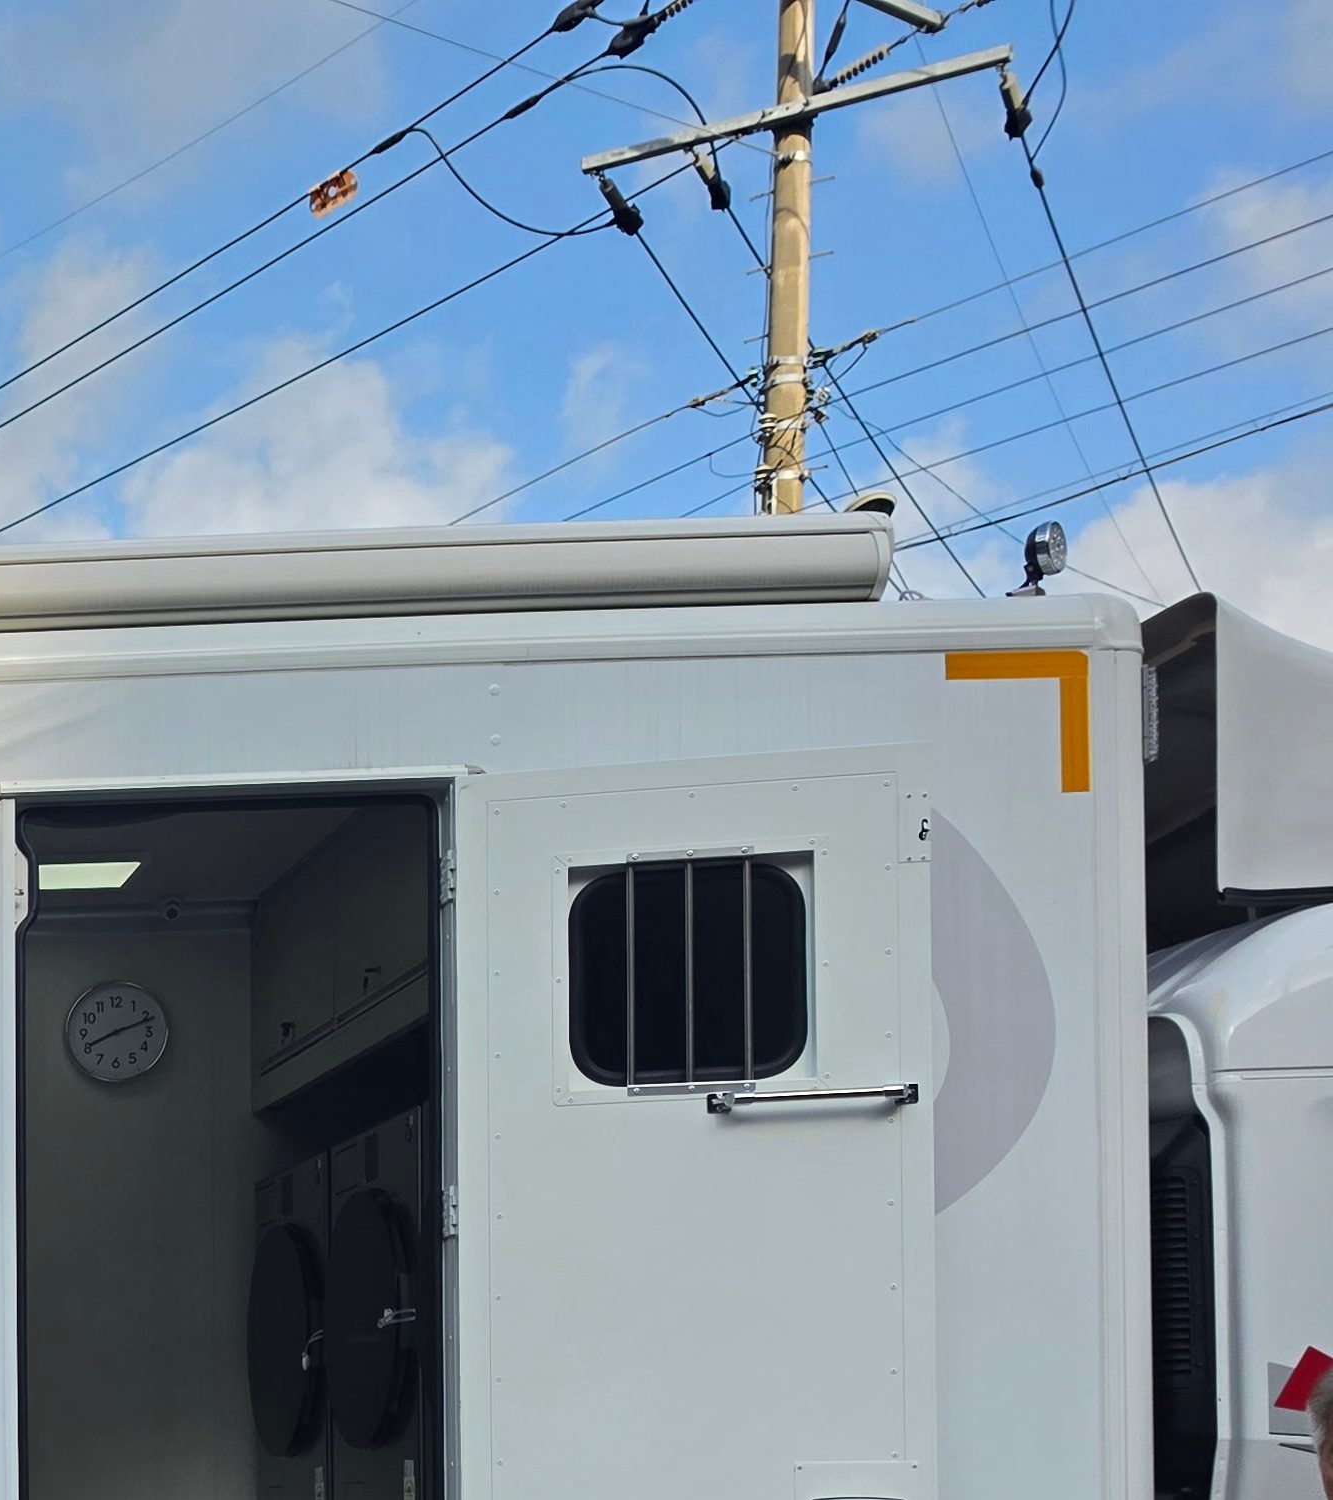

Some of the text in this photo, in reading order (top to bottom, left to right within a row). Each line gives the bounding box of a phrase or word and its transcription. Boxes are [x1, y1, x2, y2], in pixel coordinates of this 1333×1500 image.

[96, 1001, 104, 1013] 11
[110, 996, 122, 1008] 12
[131, 1000, 136, 1012] 1
[82, 1012, 96, 1024] 10
[79, 1028, 88, 1040] 9
[145, 1026, 153, 1038] 3
[84, 1042, 92, 1054] 8
[140, 1040, 148, 1053] 4
[96, 1053, 104, 1066] 7
[112, 1057, 120, 1069] 6
[128, 1052, 137, 1064] 5
